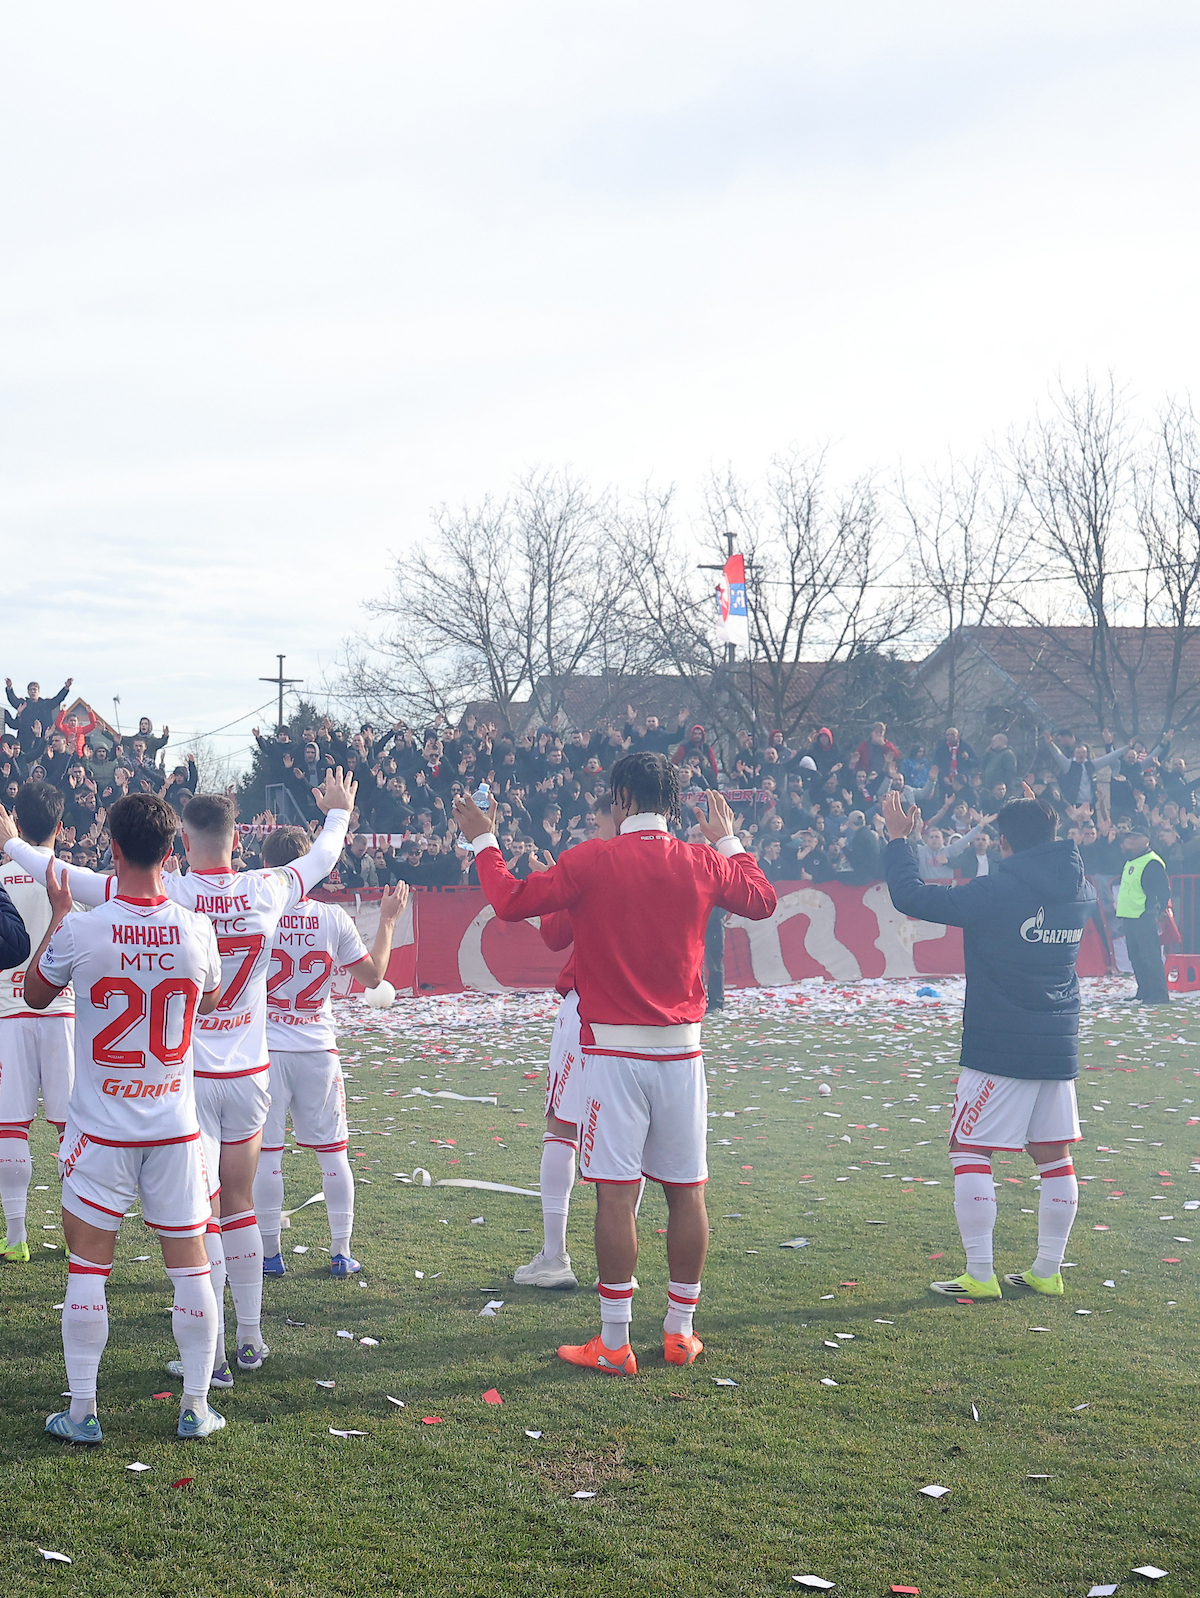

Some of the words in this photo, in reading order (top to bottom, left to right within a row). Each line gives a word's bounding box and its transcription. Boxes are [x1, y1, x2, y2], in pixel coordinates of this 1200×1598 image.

[4, 875, 34, 885] RED
[194, 894, 251, 914] ДУАРТЕ
[111, 923, 181, 946] ХАНДЕЛ
[1042, 927, 1084, 943] GAZPROM
[266, 948, 334, 1012] 22
[90, 976, 200, 1068] 20
